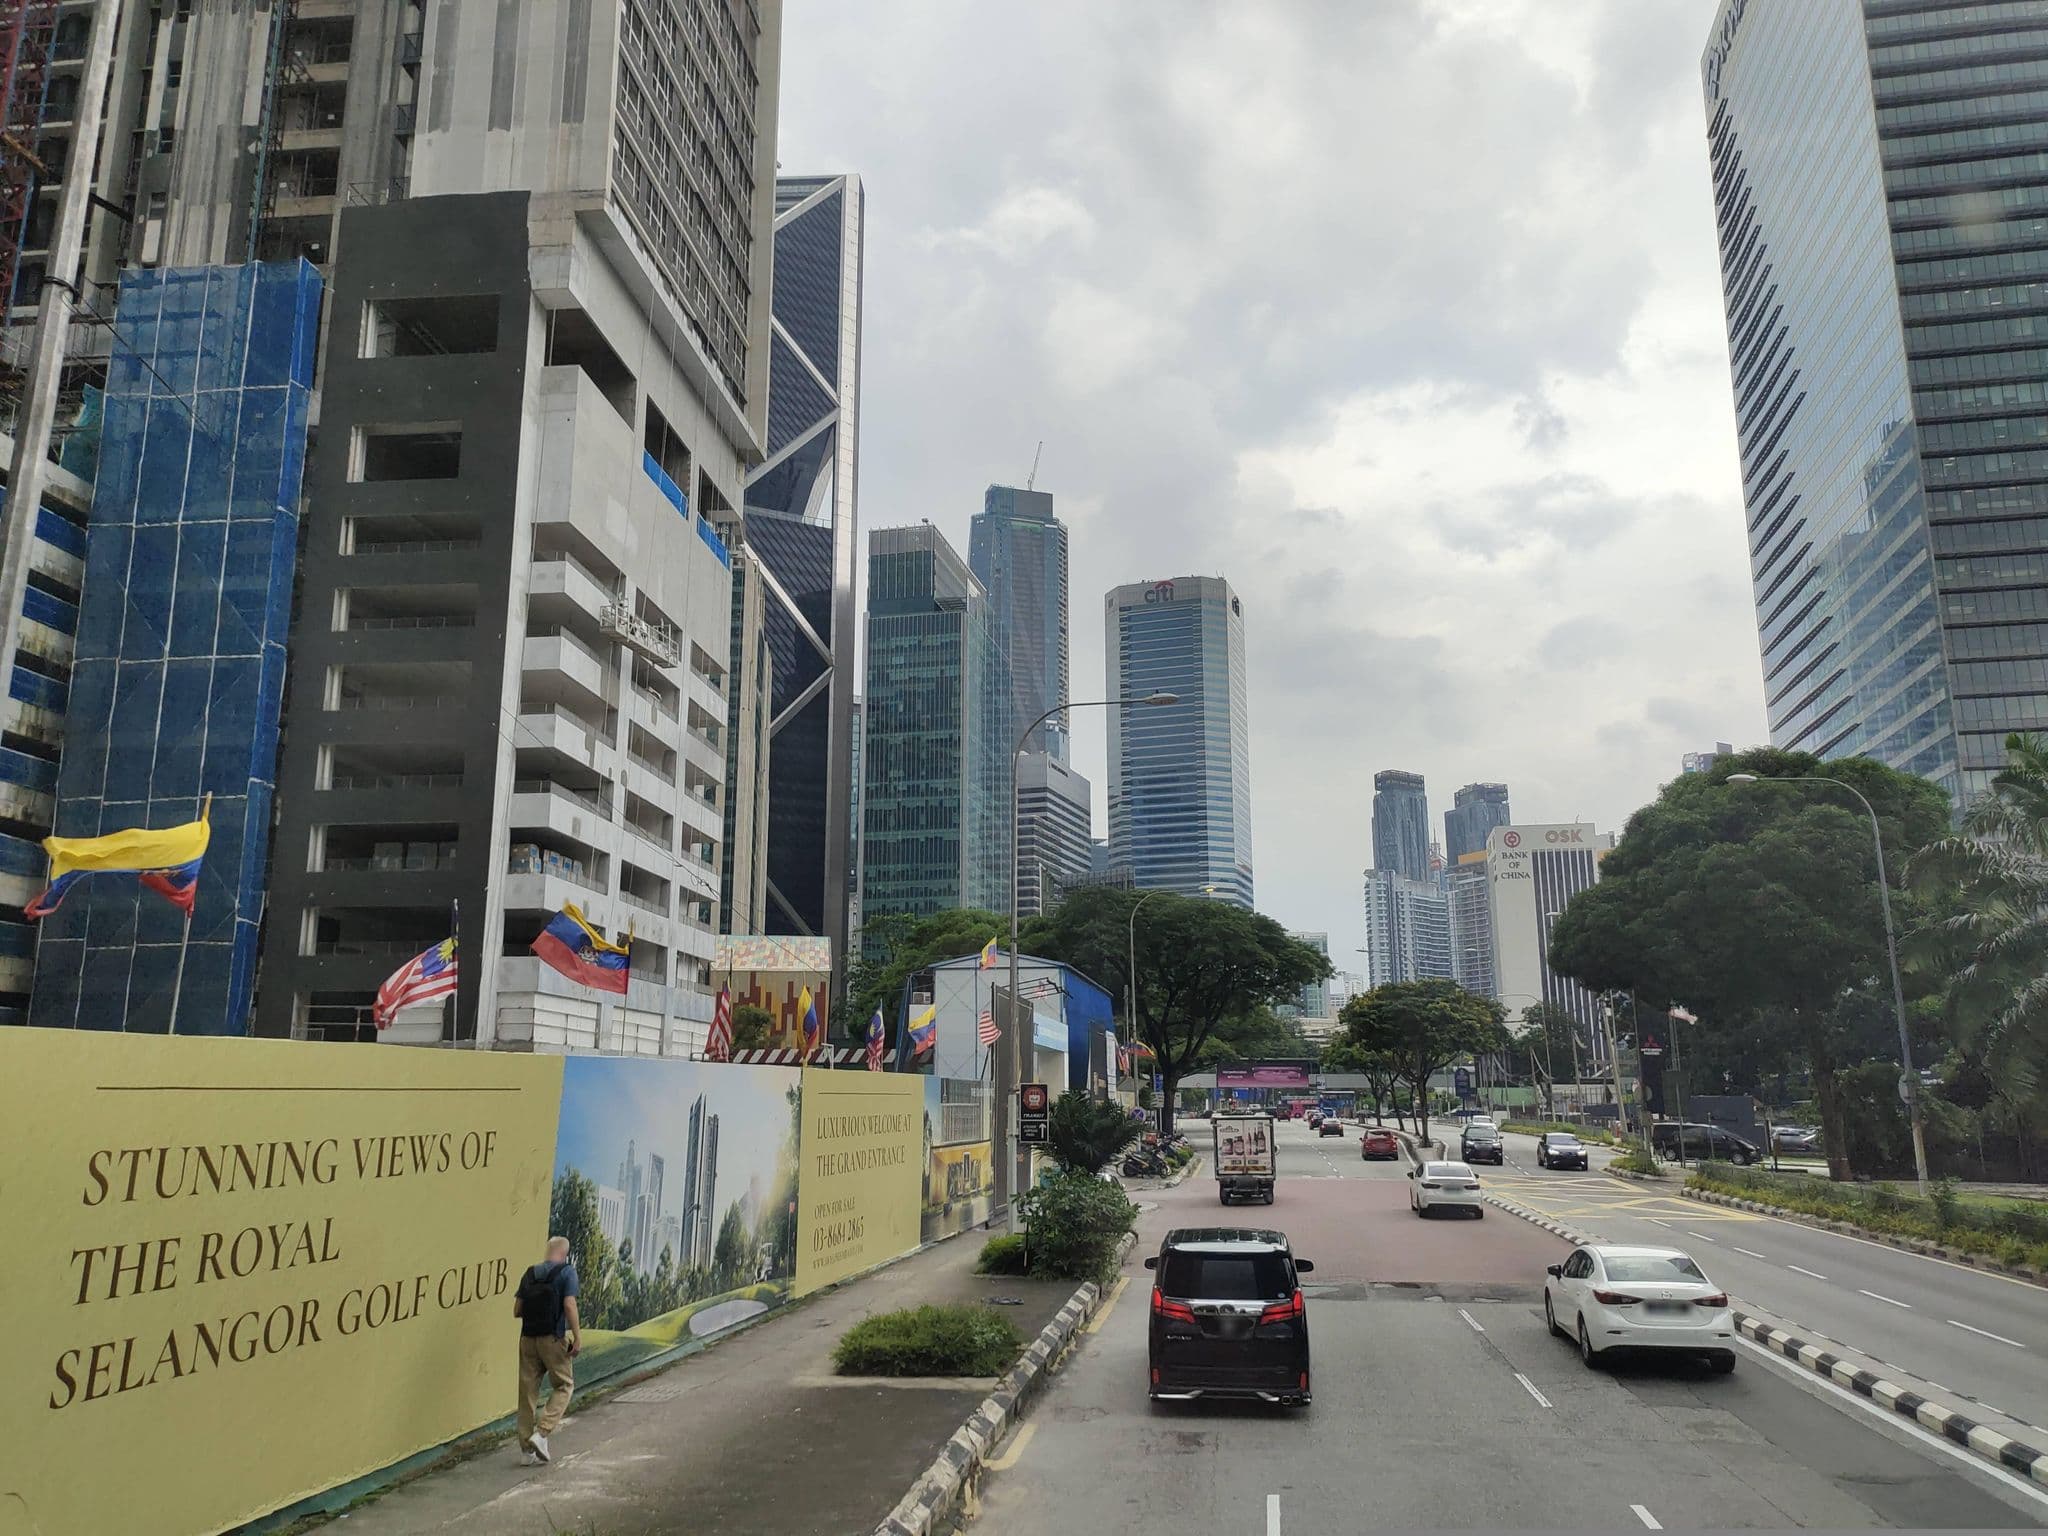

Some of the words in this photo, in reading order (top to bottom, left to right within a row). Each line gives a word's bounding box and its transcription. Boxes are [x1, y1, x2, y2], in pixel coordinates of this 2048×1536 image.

[1144, 583, 1174, 603] citi
[1545, 829, 1584, 843] OSK
[1502, 851, 1528, 860] BANK
[1508, 861, 1521, 869] OF
[1501, 871, 1531, 880] CHINA
[816, 1115, 866, 1139] LUXURIOUS
[867, 1113, 902, 1135] WELCOME
[903, 1113, 912, 1132] AT
[82, 1138, 338, 1206] STUNNING
[352, 1133, 452, 1180] VIEWS
[460, 1129, 498, 1169] OF
[816, 1153, 836, 1177] THE
[837, 1149, 867, 1174] GRAND
[868, 1145, 905, 1169] ENTRANCE
[813, 1222, 846, 1252] 03-8684
[847, 1216, 864, 1241] 2865
[71, 1237, 181, 1306] THE
[196, 1217, 341, 1284] ROYAL
[49, 1298, 320, 1410] SELANGOR
[336, 1274, 429, 1336] GOLF
[437, 1257, 509, 1310] CLUB
